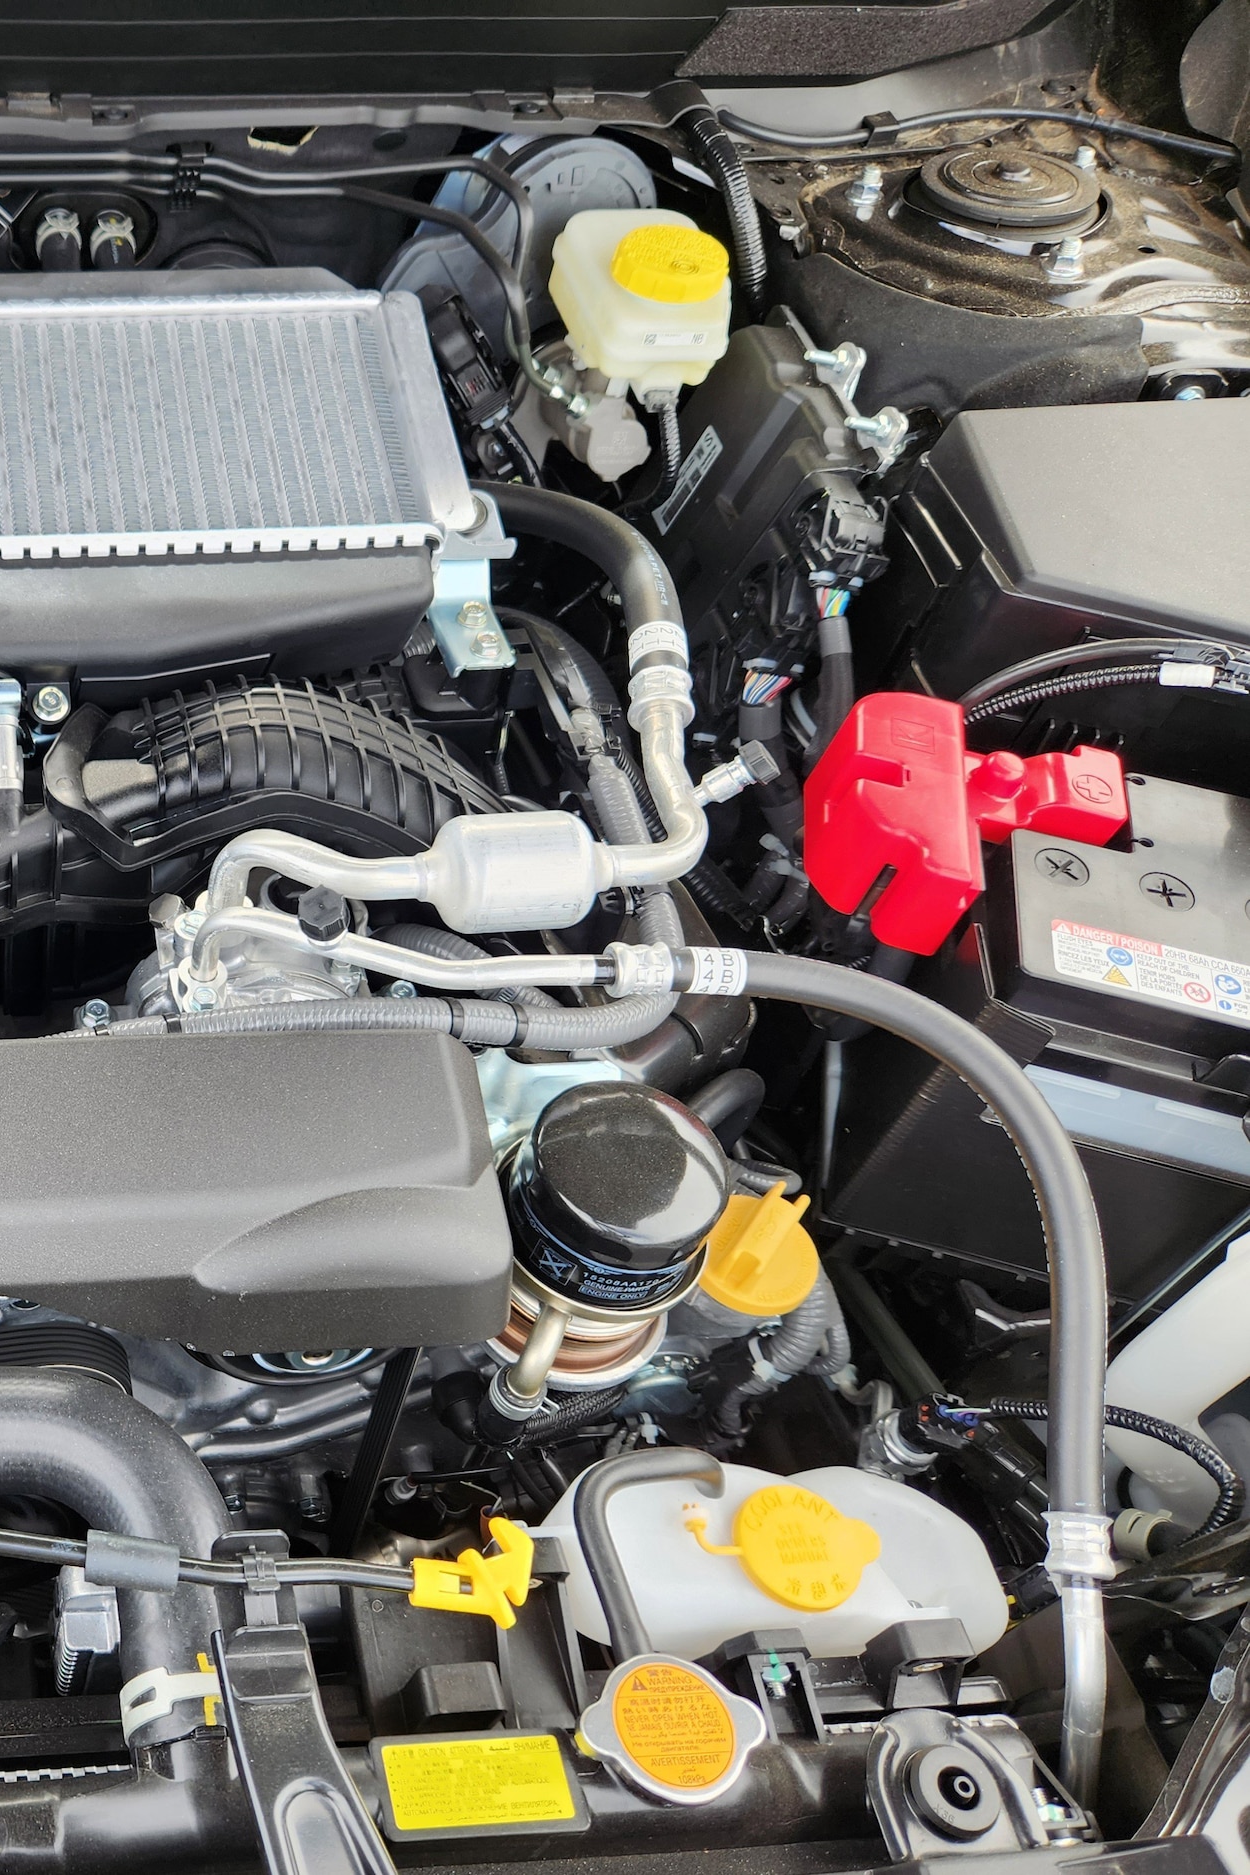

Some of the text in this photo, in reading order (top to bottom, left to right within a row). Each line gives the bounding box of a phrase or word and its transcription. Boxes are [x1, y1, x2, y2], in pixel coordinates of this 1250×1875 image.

[1072, 926, 1114, 945] DANGER
[1121, 937, 1159, 955] POISON
[1164, 949, 1187, 961] 20HR
[1211, 960, 1230, 972] CCA
[1169, 968, 1200, 980] CHILDREN
[583, 1280, 624, 1292] GENUINE
[581, 1286, 646, 1299] ENGINE ONLY
[647, 1675, 692, 1686] WARNING
[624, 1715, 648, 1723] NEVER
[653, 1713, 674, 1722] OPEN
[677, 1712, 700, 1721] WHEN
[651, 1754, 720, 1767] AVERTISSEMENT
